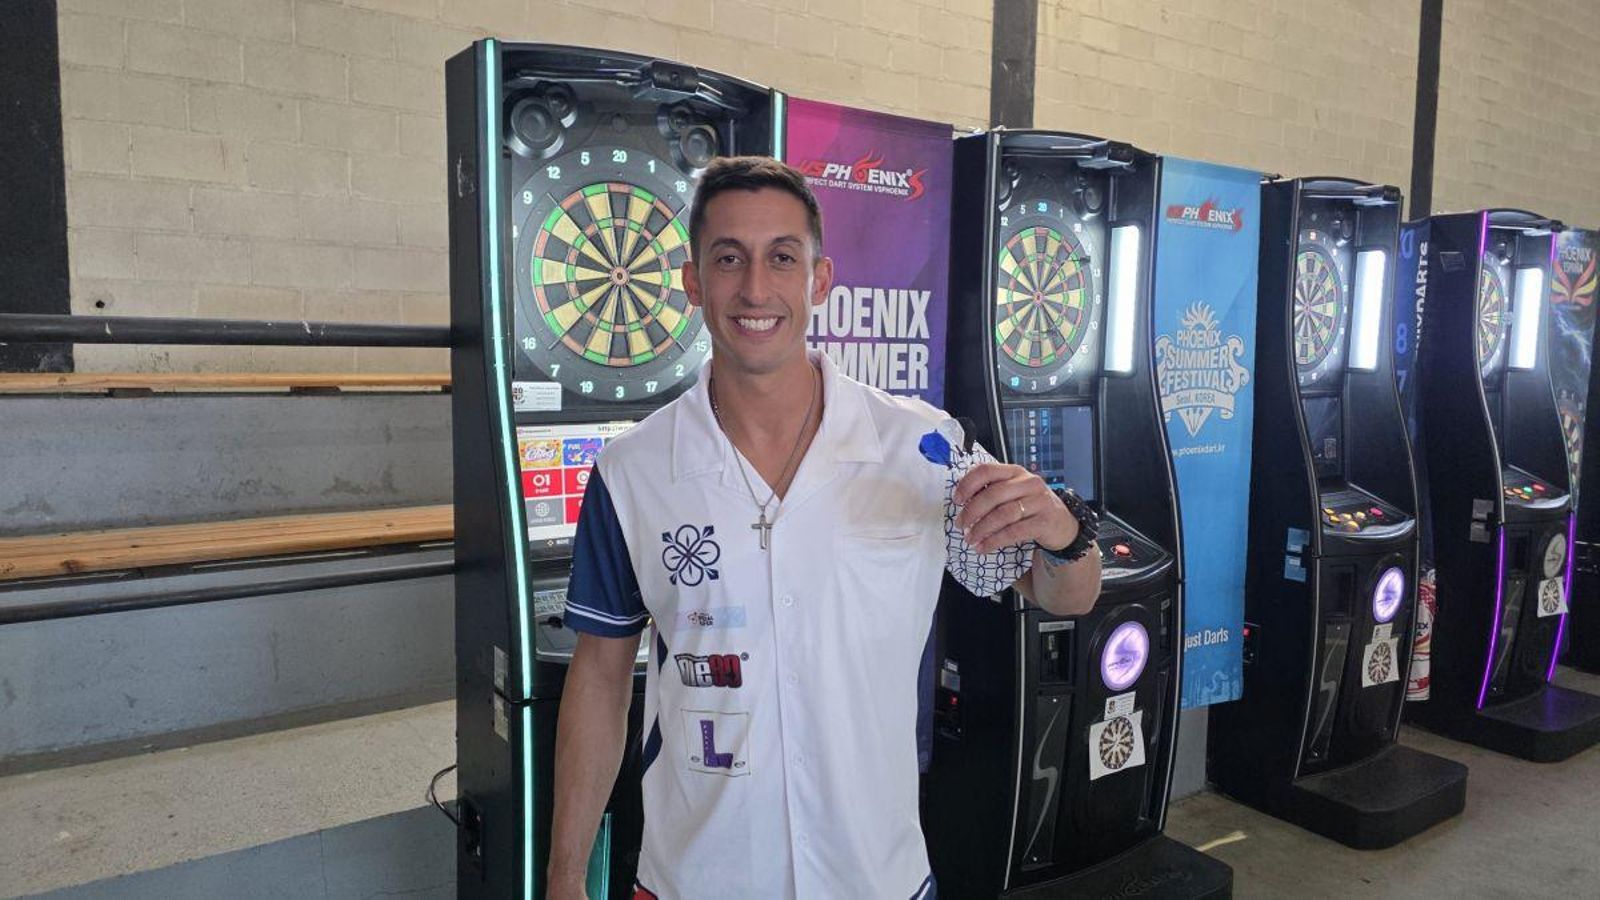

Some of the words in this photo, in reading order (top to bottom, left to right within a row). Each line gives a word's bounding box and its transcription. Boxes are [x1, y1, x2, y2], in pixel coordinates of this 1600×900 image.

[580, 152, 590, 165] 5
[613, 150, 627, 163] 20
[547, 166, 561, 179] 12
[648, 160, 656, 173] 1
[675, 180, 687, 192] 18
[829, 180, 846, 189] DART
[523, 191, 533, 204] 9
[807, 285, 931, 339] HOENIX
[522, 337, 537, 349] 16
[1176, 330, 1221, 348] PHOENIX
[1167, 345, 1229, 370] SUMMER
[550, 364, 560, 377] 7
[675, 365, 684, 377] 2
[807, 342, 929, 389] MMER
[580, 381, 593, 393] 19
[644, 381, 658, 393] 17
[1165, 370, 1229, 394] FESTIVAL
[616, 386, 624, 398] 3
[1204, 627, 1229, 646] Darts
[700, 719, 734, 769] L
